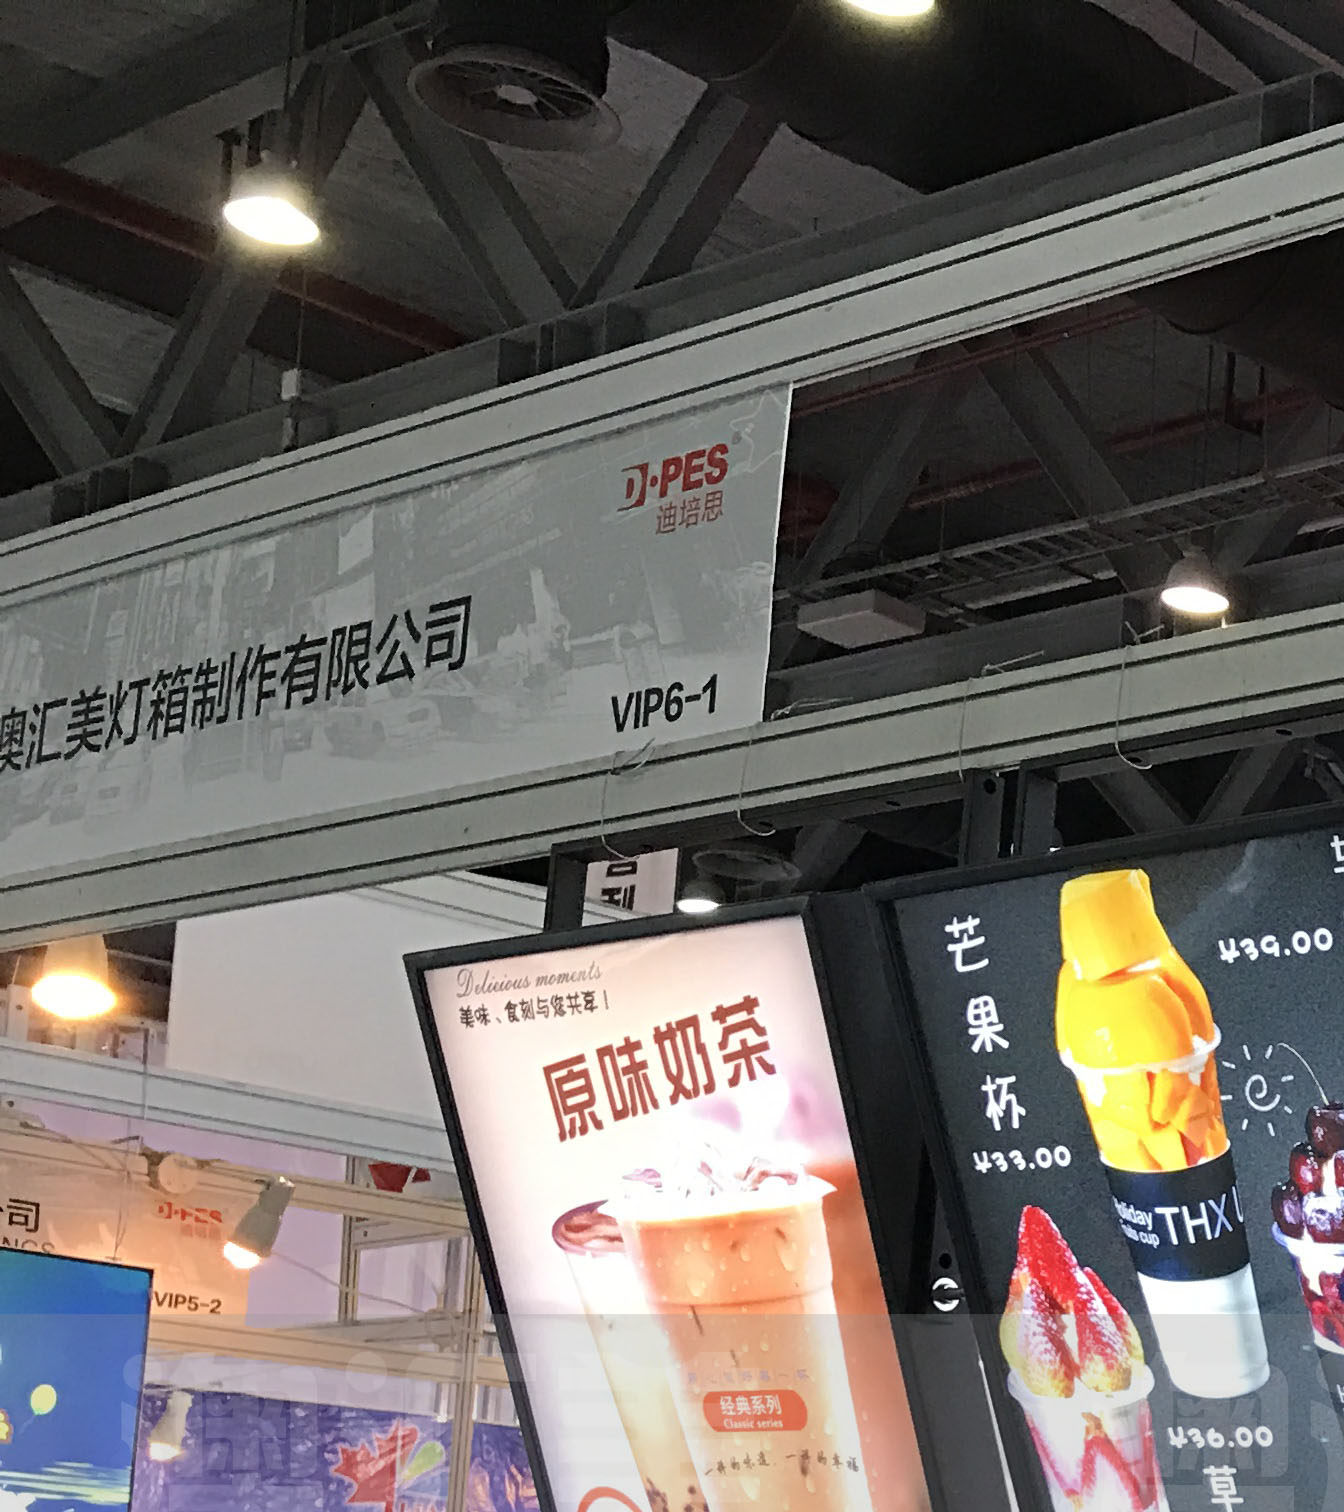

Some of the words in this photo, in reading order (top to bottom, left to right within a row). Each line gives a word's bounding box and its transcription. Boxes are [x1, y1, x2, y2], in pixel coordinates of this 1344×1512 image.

[655, 491, 725, 536] 迪培思
[610, 674, 720, 734] VIP6-1
[1217, 927, 1334, 964] ¥39.00
[535, 959, 604, 986] moments
[943, 914, 1028, 1131] 芒果杯
[541, 994, 778, 1143] 原味奶茶
[972, 1145, 1073, 1175] ¥33.00
[0, 1198, 41, 1233] 司
[153, 1290, 223, 1315] VIP5-2
[719, 1393, 783, 1416] 经典系列
[723, 1417, 754, 1429] Classic
[757, 1418, 784, 1429] series
[1167, 1424, 1274, 1449] ¥36.00
